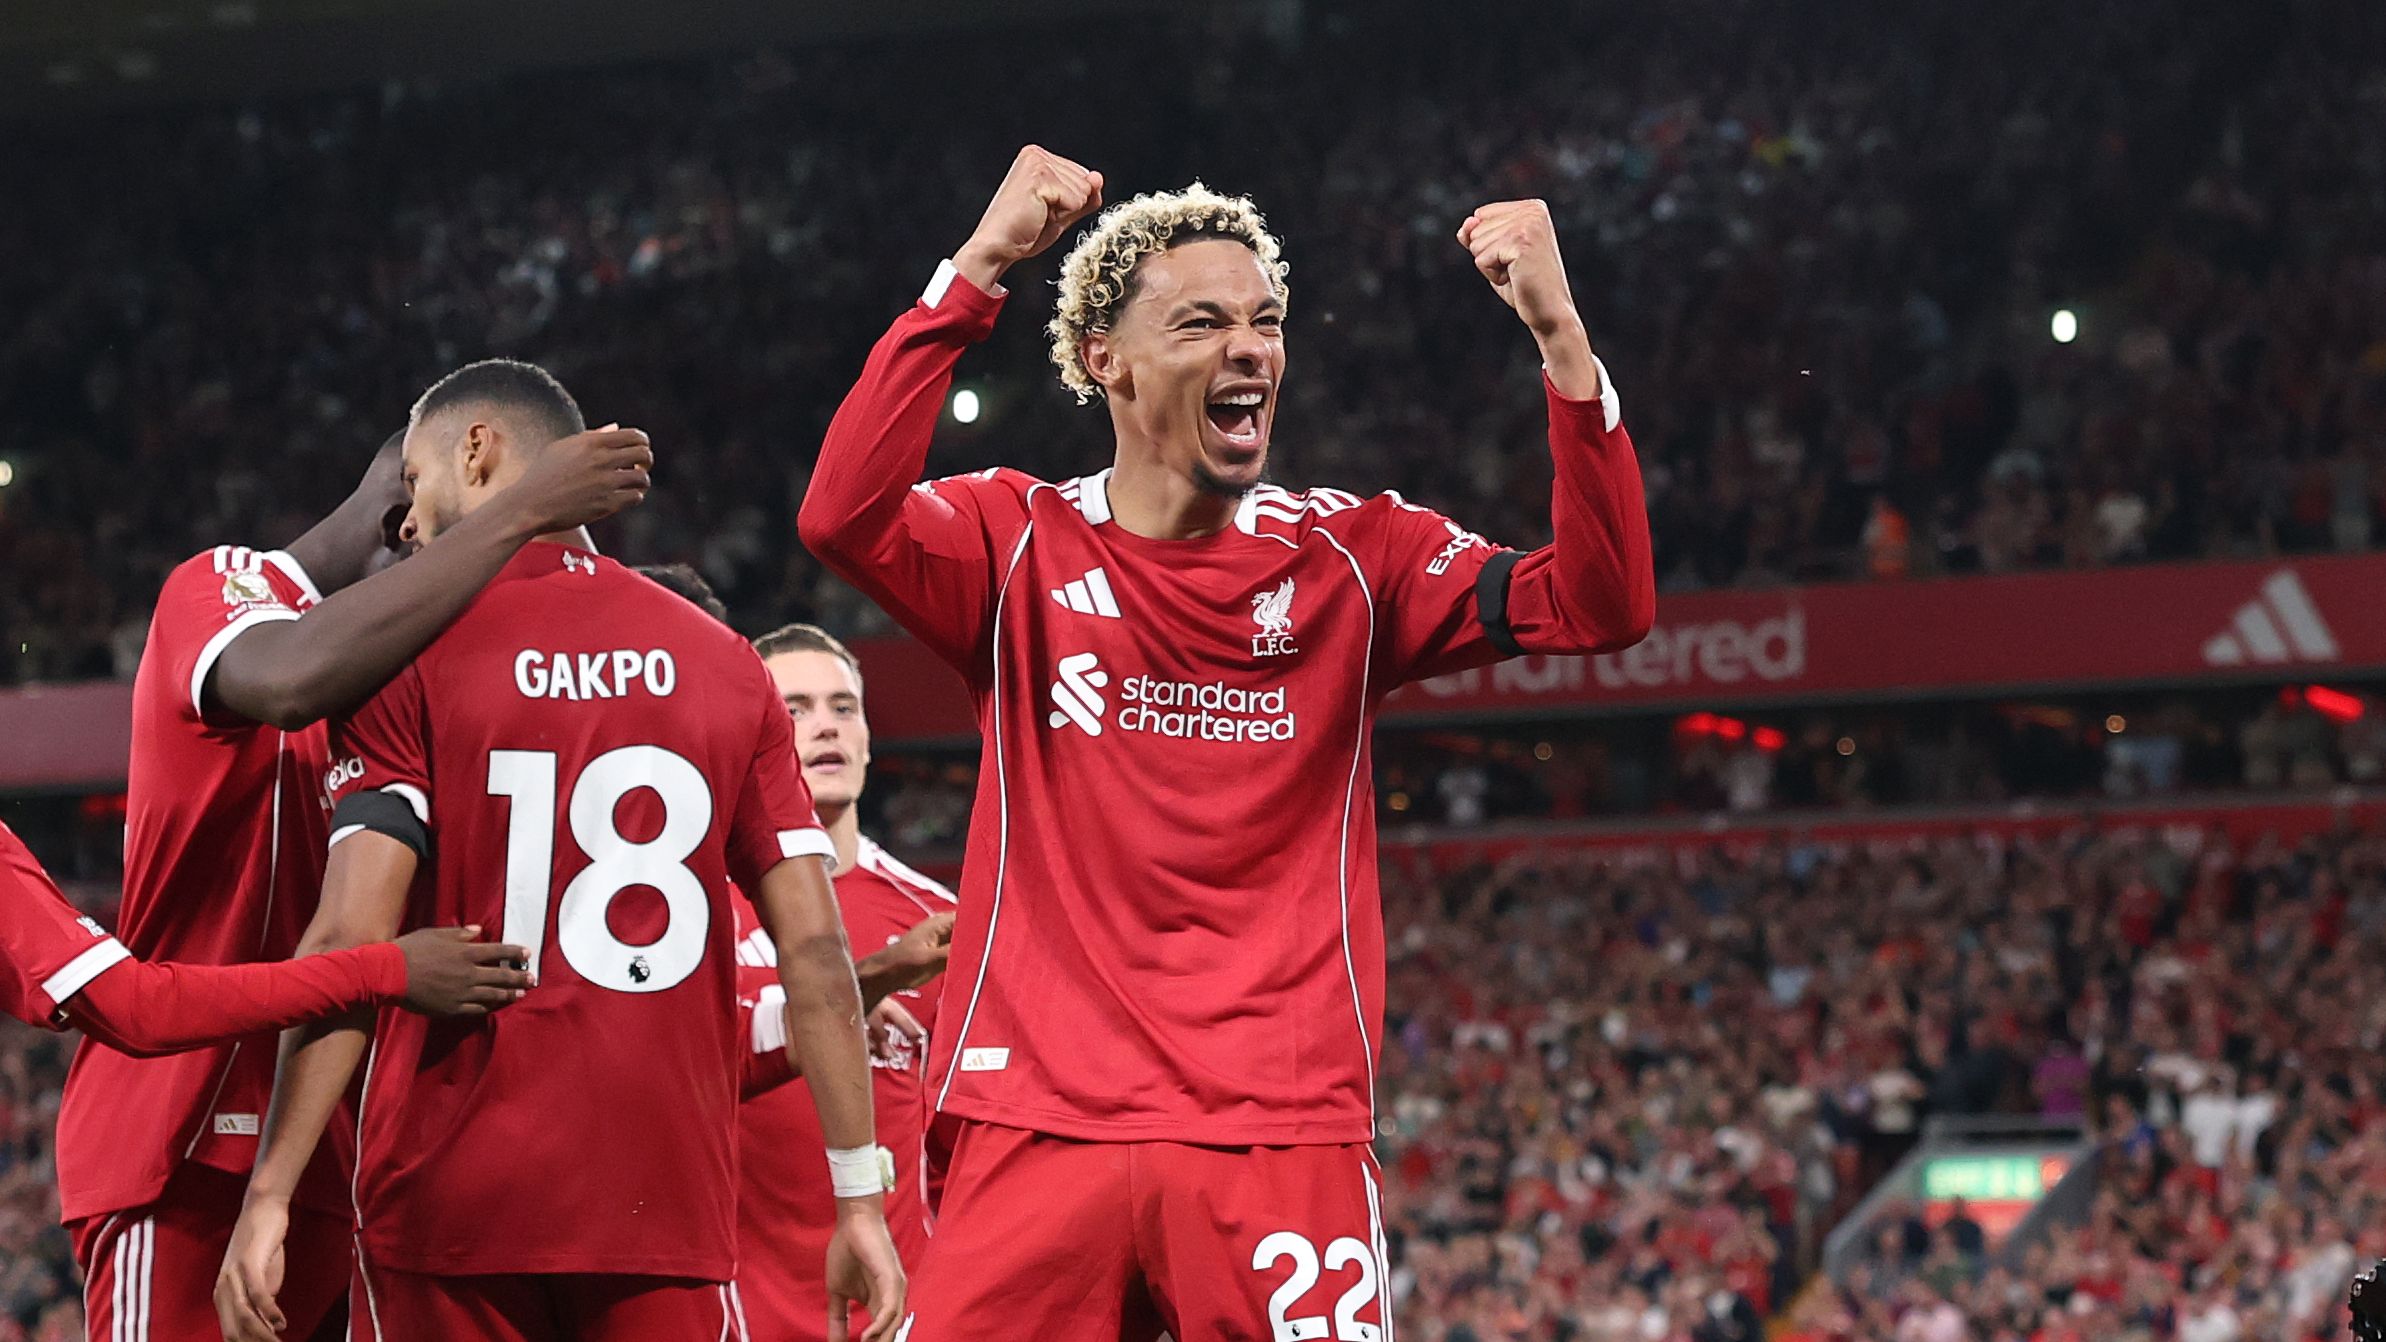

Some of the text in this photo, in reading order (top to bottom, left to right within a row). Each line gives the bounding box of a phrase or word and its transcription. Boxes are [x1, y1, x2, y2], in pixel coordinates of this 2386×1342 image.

[1252, 636, 1299, 657] L.F.C.
[514, 648, 677, 701] GAKPO
[1121, 674, 1285, 714] standard
[1118, 703, 1295, 742] chartered
[487, 744, 714, 993] 18
[1252, 1231, 1381, 1342] 22
